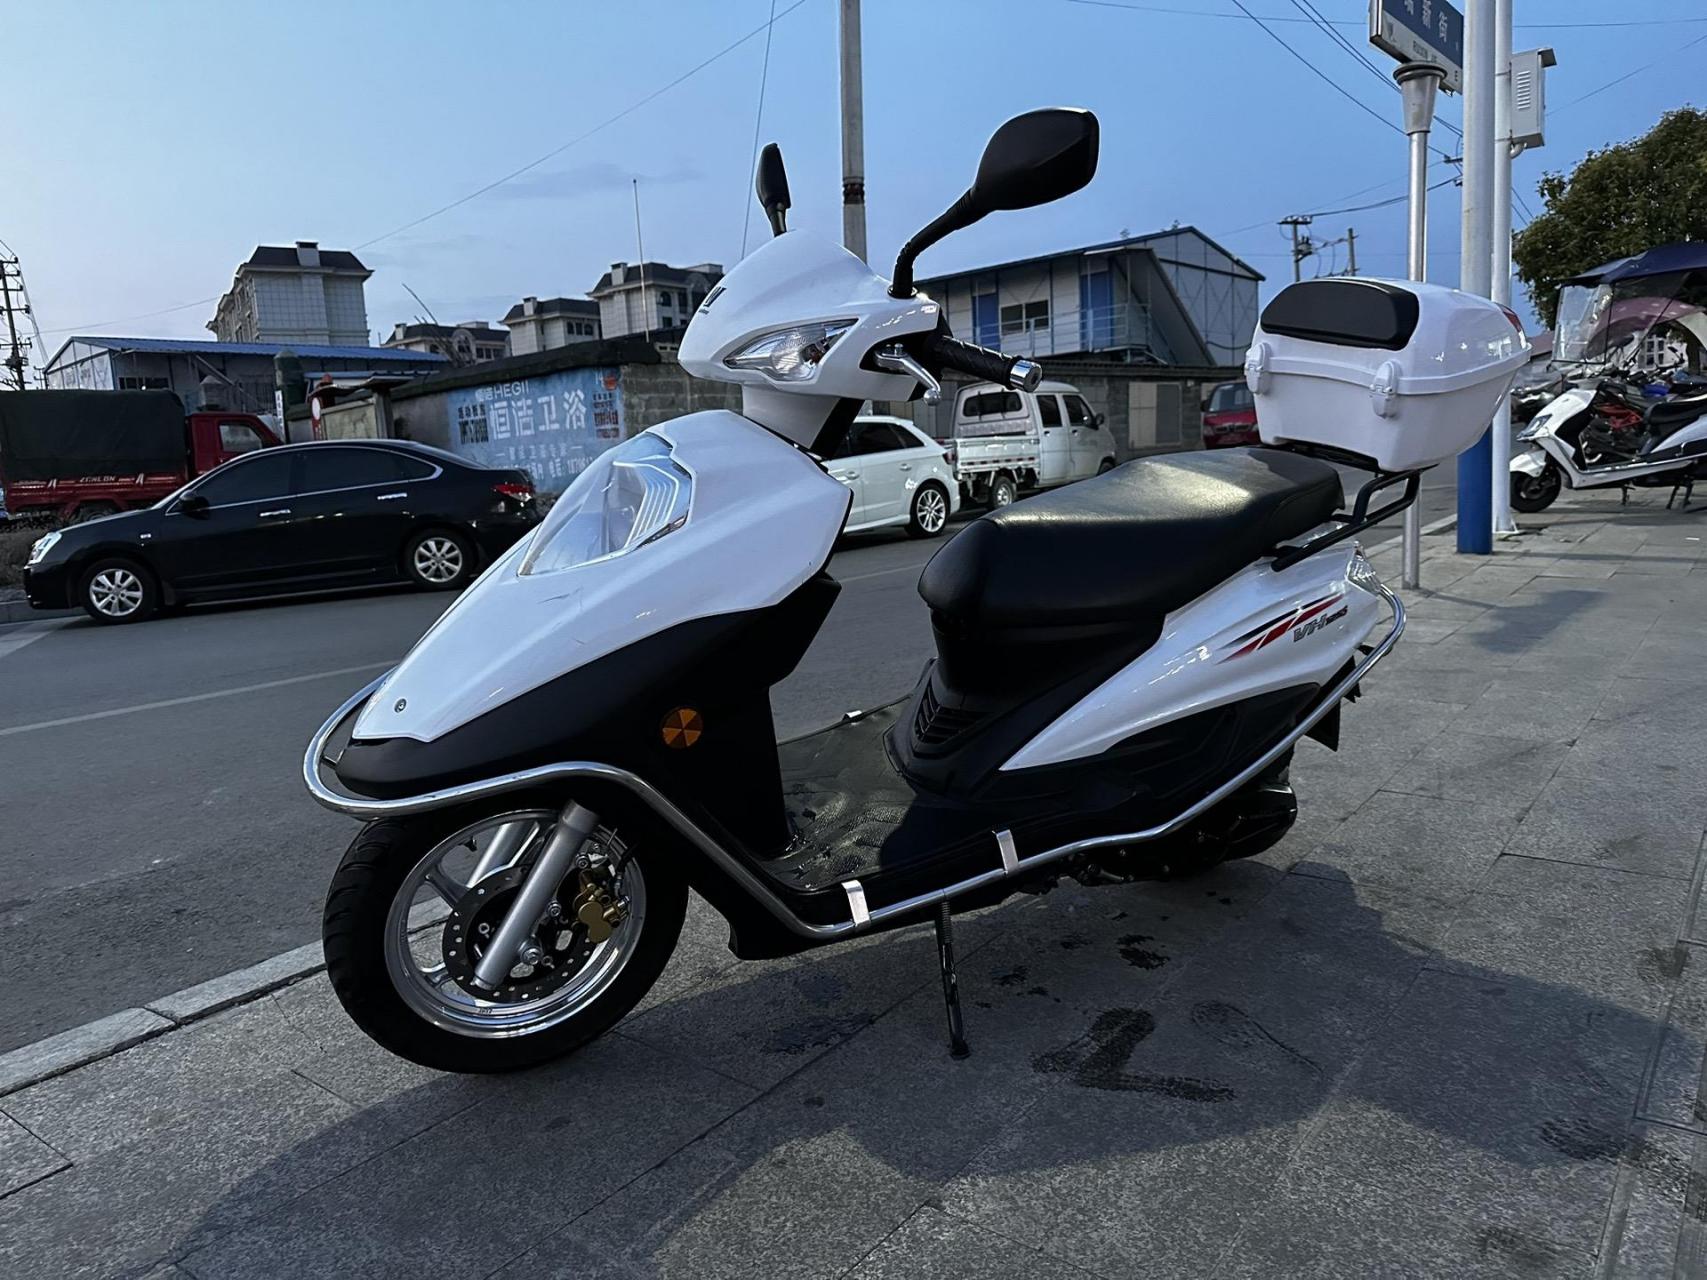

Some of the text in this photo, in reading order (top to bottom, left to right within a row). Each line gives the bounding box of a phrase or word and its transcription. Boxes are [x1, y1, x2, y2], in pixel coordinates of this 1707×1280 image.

[494, 380, 529, 399] HEGII
[489, 388, 587, 441] 恒洁卫浴
